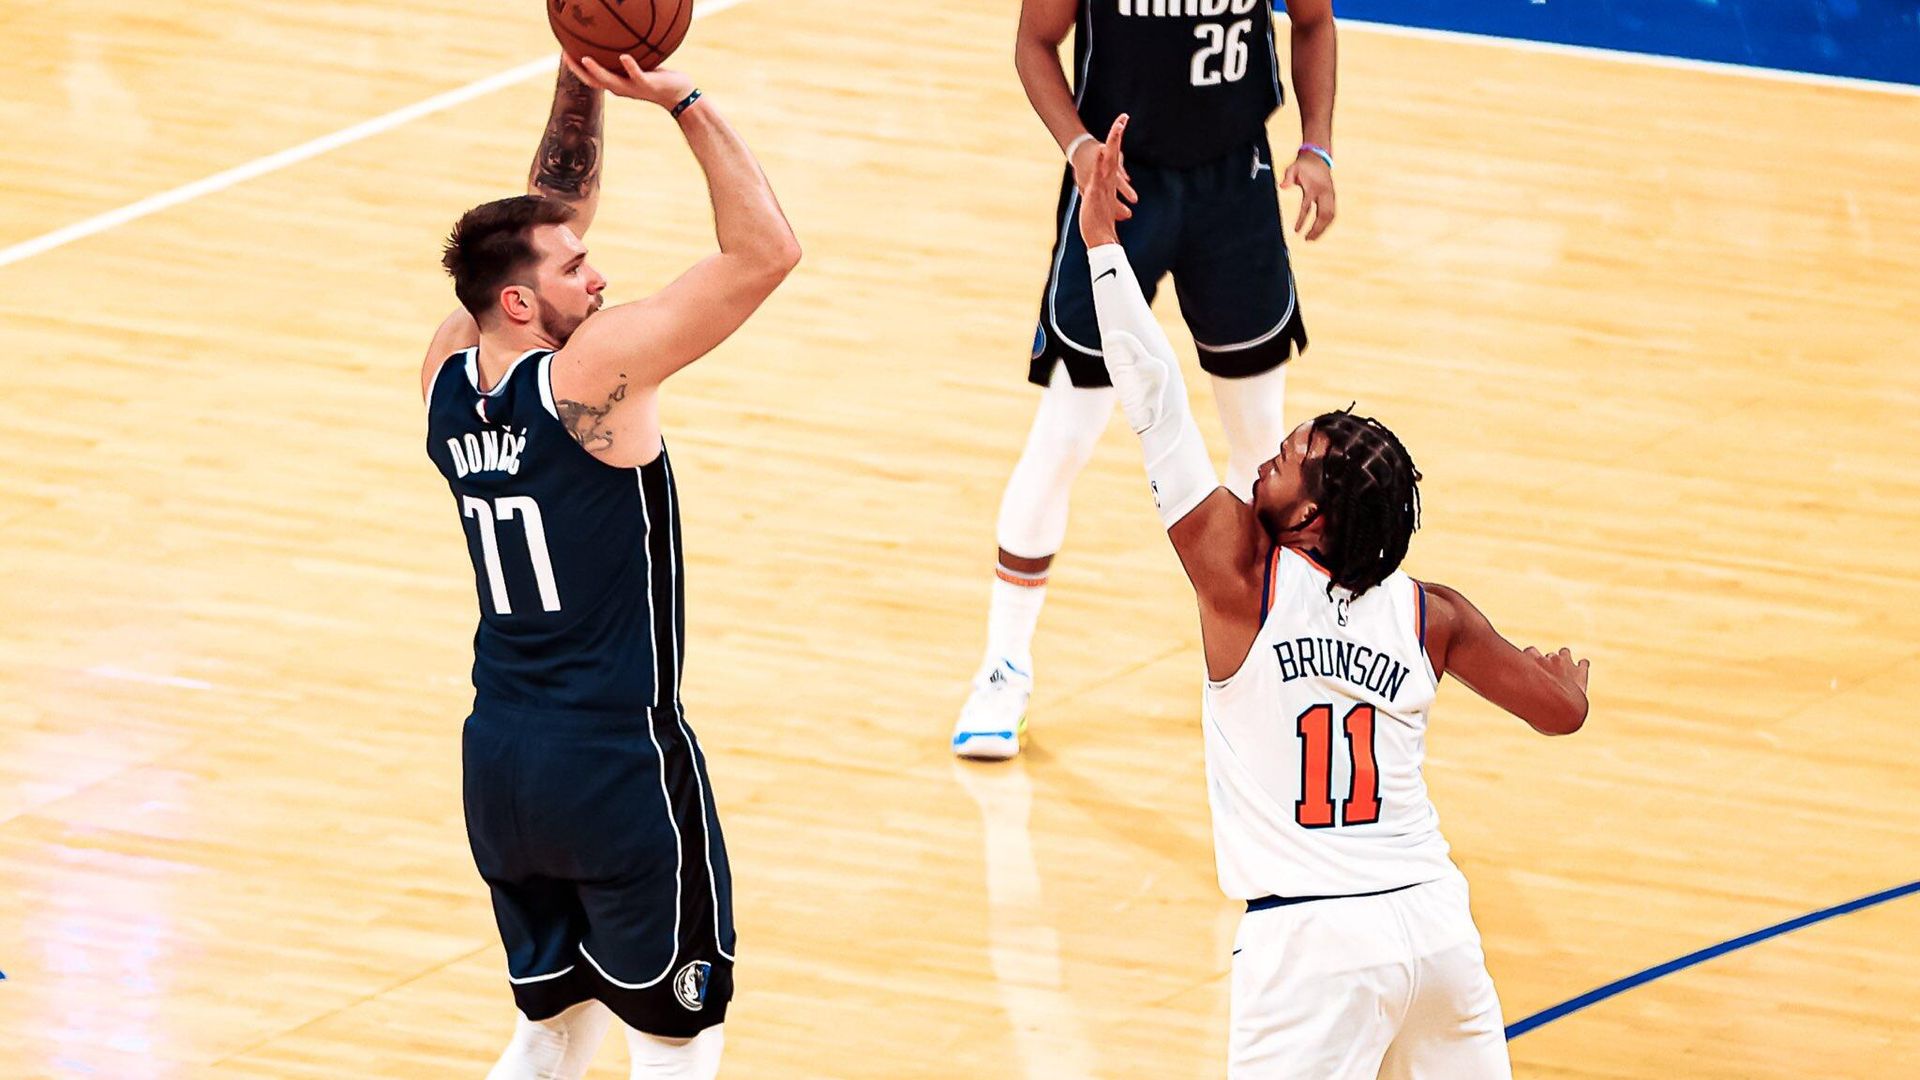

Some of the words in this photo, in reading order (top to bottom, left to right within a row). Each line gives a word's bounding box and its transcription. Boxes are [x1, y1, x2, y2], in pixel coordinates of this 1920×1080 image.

[1190, 19, 1252, 86] 26
[446, 424, 527, 479] DONČĆ
[463, 495, 561, 614] 77
[1273, 637, 1410, 702] BRUNSON
[1295, 703, 1382, 829] 11
